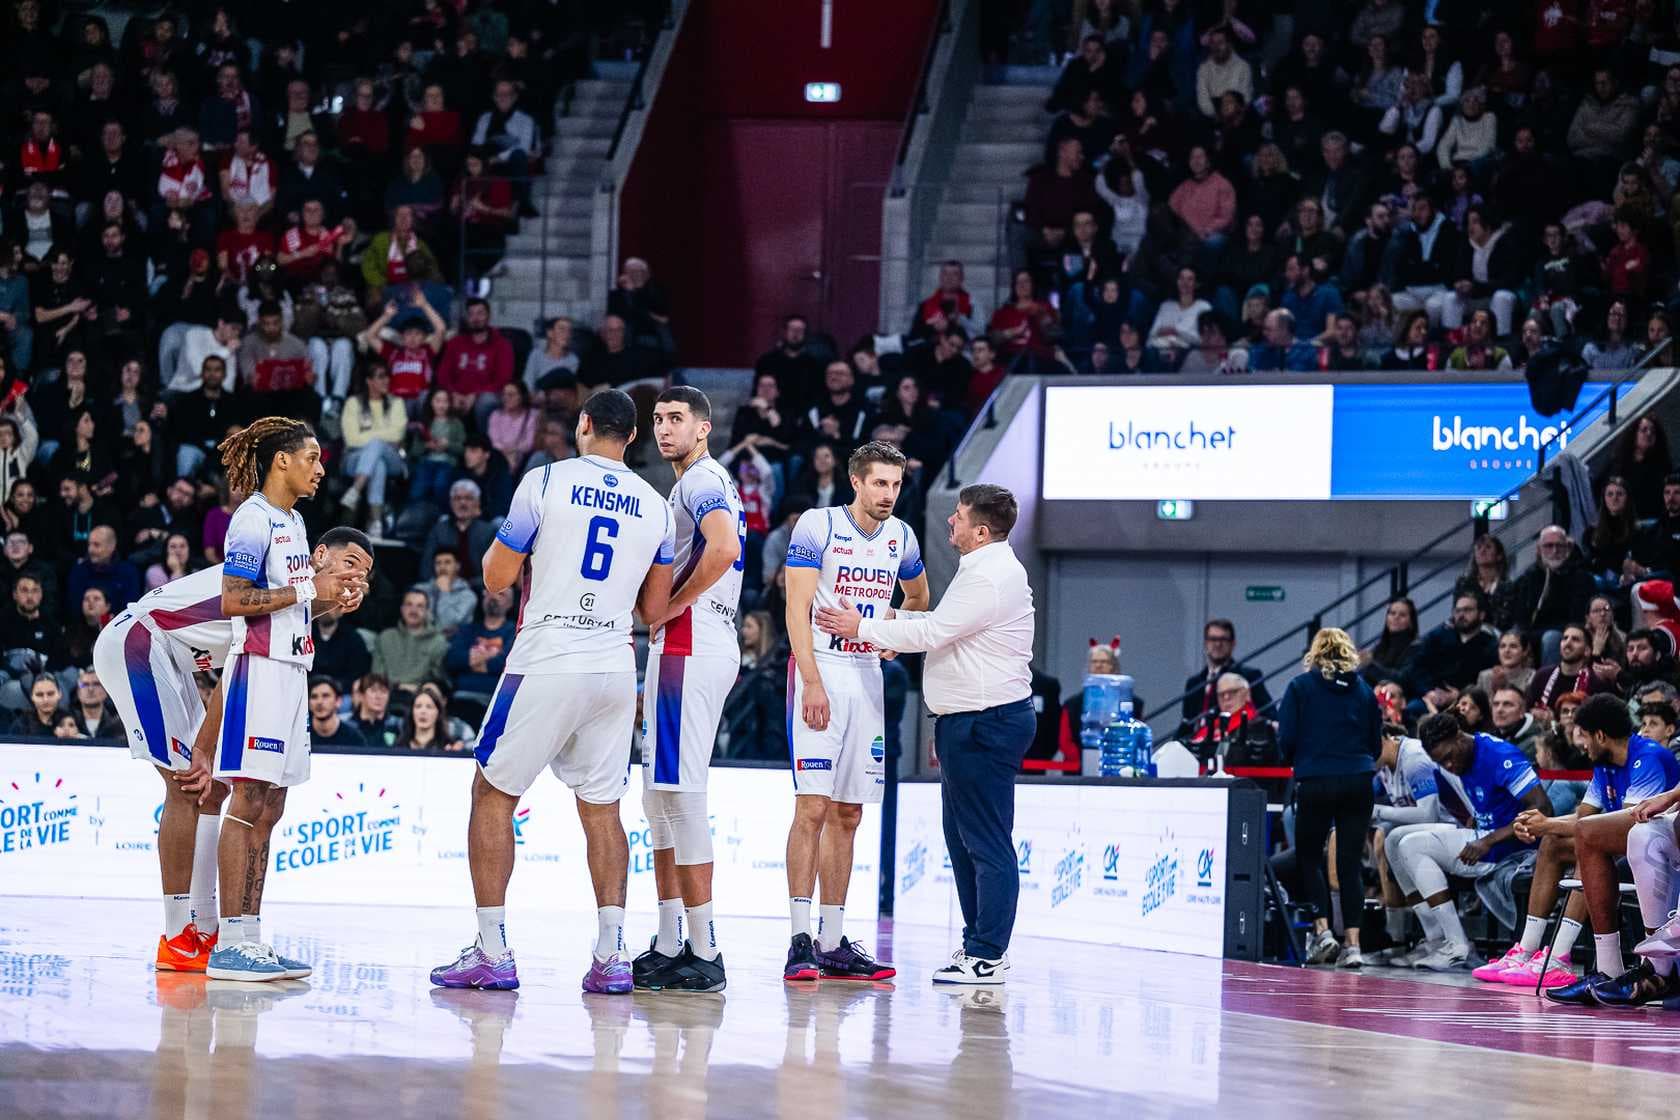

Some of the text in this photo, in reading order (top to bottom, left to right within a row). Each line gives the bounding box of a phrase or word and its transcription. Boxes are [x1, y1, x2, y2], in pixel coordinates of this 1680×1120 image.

[1109, 419, 1236, 449] blanchet
[1433, 415, 1572, 450] blanchet
[571, 484, 643, 518] KENSMIL
[235, 552, 259, 565] BRED
[580, 515, 620, 581] 6
[836, 565, 896, 588] ROUEN
[584, 597, 594, 607] 21
[834, 584, 892, 600] METROPOLE
[255, 739, 279, 750] Rouen
[801, 760, 824, 769] Rouen
[37, 820, 70, 846] VIE
[297, 811, 368, 845] SPORT
[361, 830, 394, 855] VIE
[276, 841, 340, 872] ECOLE
